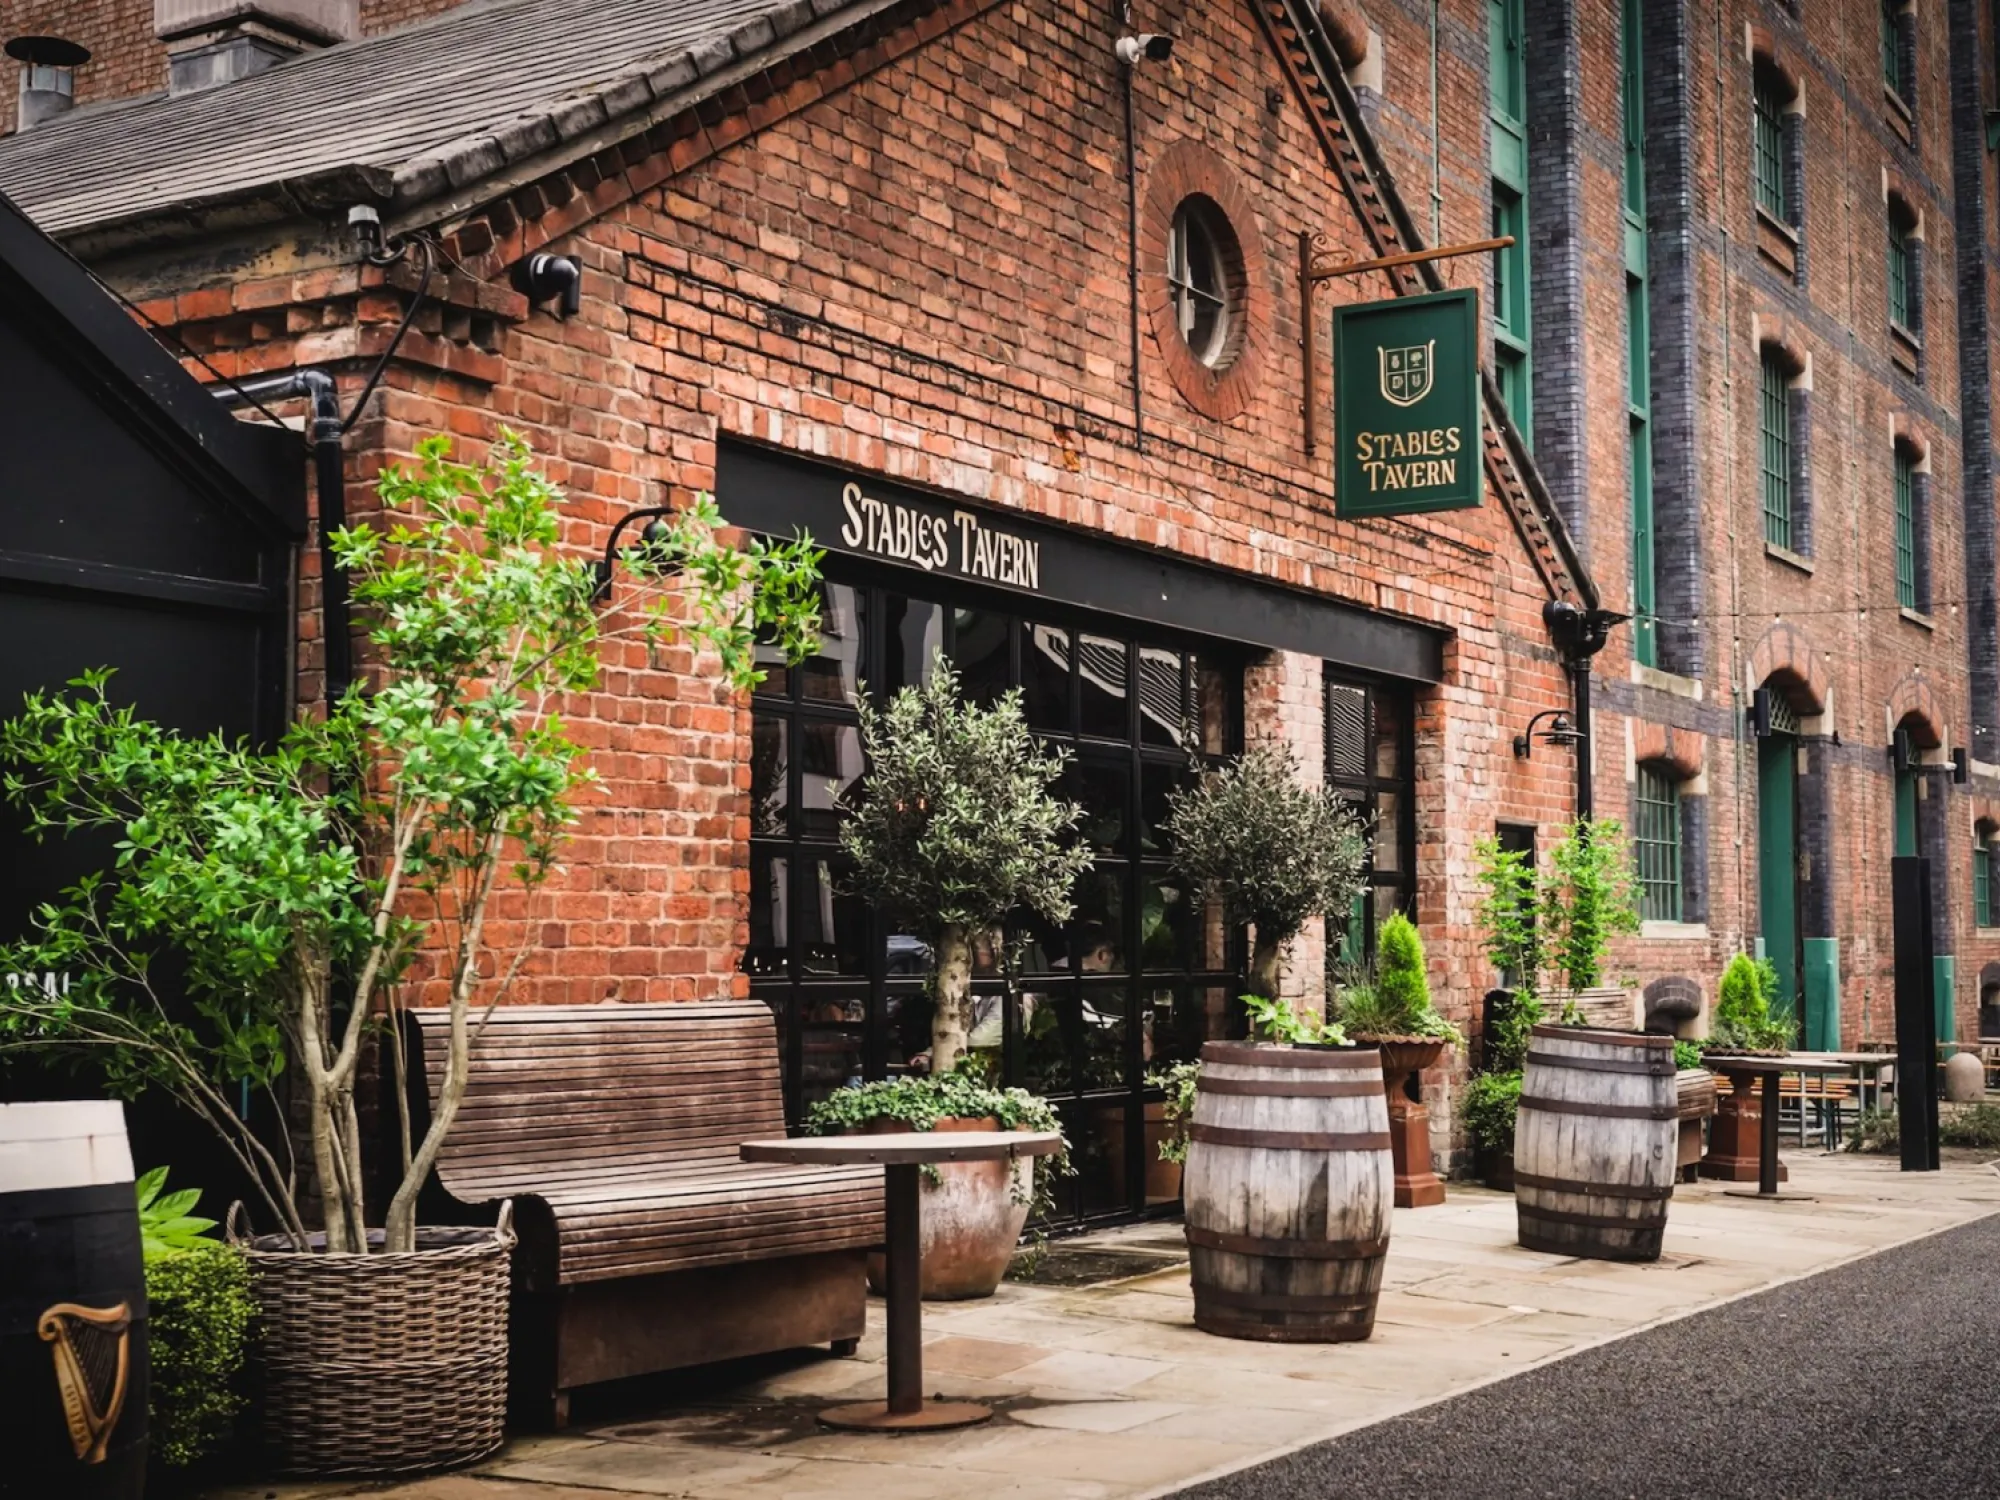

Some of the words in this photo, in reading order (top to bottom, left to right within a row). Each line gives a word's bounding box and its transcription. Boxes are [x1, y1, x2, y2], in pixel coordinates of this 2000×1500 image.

[1356, 427, 1461, 461] STABLES
[1362, 458, 1457, 492] TAVERN
[841, 482, 949, 571] STABLES
[953, 509, 1040, 590] TAVERN
